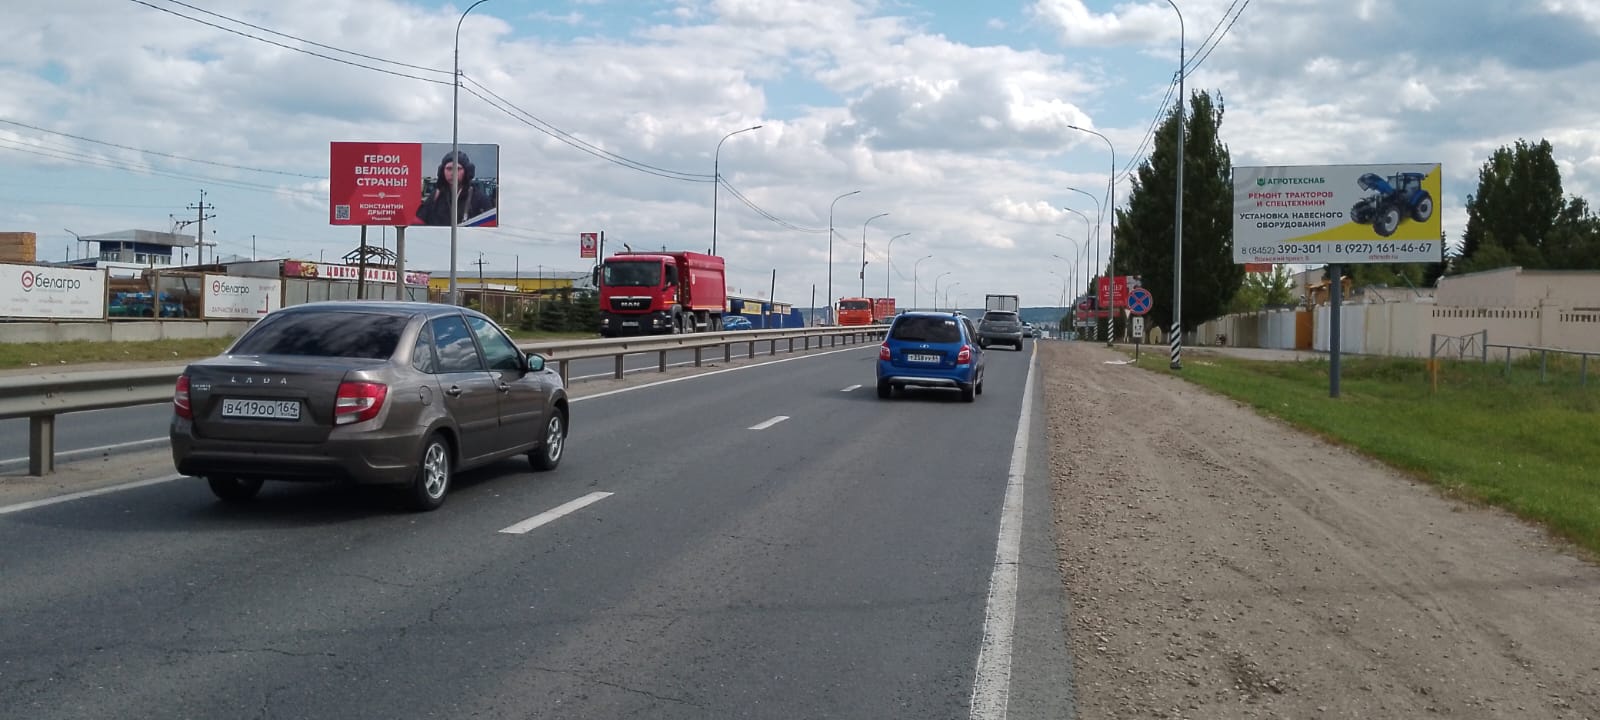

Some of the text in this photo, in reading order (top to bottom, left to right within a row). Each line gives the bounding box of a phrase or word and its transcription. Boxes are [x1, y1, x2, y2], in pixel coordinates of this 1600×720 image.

[364, 155, 400, 163] ГЕРОИ
[355, 165, 409, 175] ВЕЛИКОЙ
[356, 178, 407, 187] СТРАНЫ!
[1267, 176, 1325, 185] АГРОТЕХСНАБ
[1285, 191, 1333, 199] ТРАКТОРОВ
[1265, 199, 1325, 208] СПЕЦТЕХНИКИ
[1239, 211, 1343, 220] УСТАНОВКА НАВЕСНОГО
[1256, 220, 1326, 229] ОБОРУДОВАНИЯ
[1249, 246, 1275, 255] (8452)
[1277, 244, 1321, 254] 390-301
[1335, 243, 1432, 254] 8 (927) 161-46-67
[327, 266, 378, 280] ЦВЕТОНАЯ
[35, 273, 81, 292] белагро
[221, 282, 250, 296] белагро
[231, 376, 287, 385] LADA
